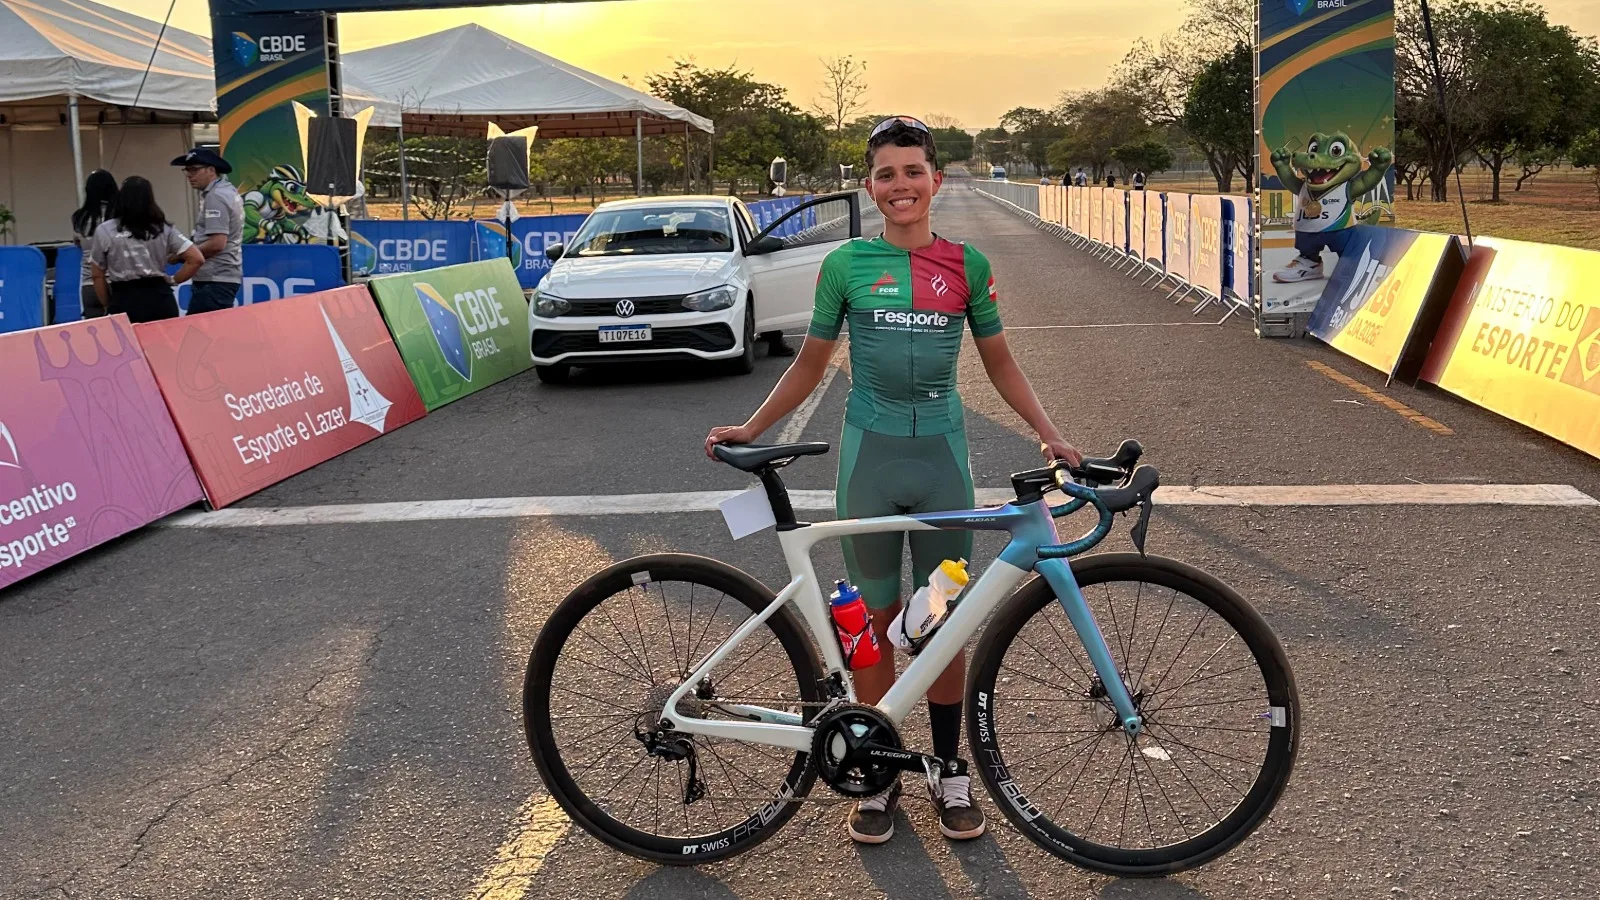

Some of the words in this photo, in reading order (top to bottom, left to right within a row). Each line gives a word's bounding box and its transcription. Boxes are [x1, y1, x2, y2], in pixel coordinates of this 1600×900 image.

[1317, 0, 1347, 8] BRASIL
[259, 35, 306, 53] CBDE
[378, 239, 448, 261] CBDE
[379, 263, 413, 273] BRASIL
[454, 286, 510, 336] CBDE
[873, 309, 949, 327] Fesporte
[1555, 301, 1584, 331] DO
[472, 336, 500, 360] BRASIL
[1472, 322, 1568, 380] ESPORTE
[224, 376, 306, 421] Secretaria
[304, 371, 324, 396] de
[232, 423, 298, 465] Esporte
[297, 421, 310, 441] e
[305, 405, 347, 437] Lazer
[0, 481, 77, 527] centivo
[0, 522, 70, 568] sporte
[978, 691, 988, 710] DT
[978, 711, 991, 743] SWISS
[870, 749, 912, 760] ULTEGRA
[682, 844, 699, 855] DT
[701, 837, 730, 853] SWISS
